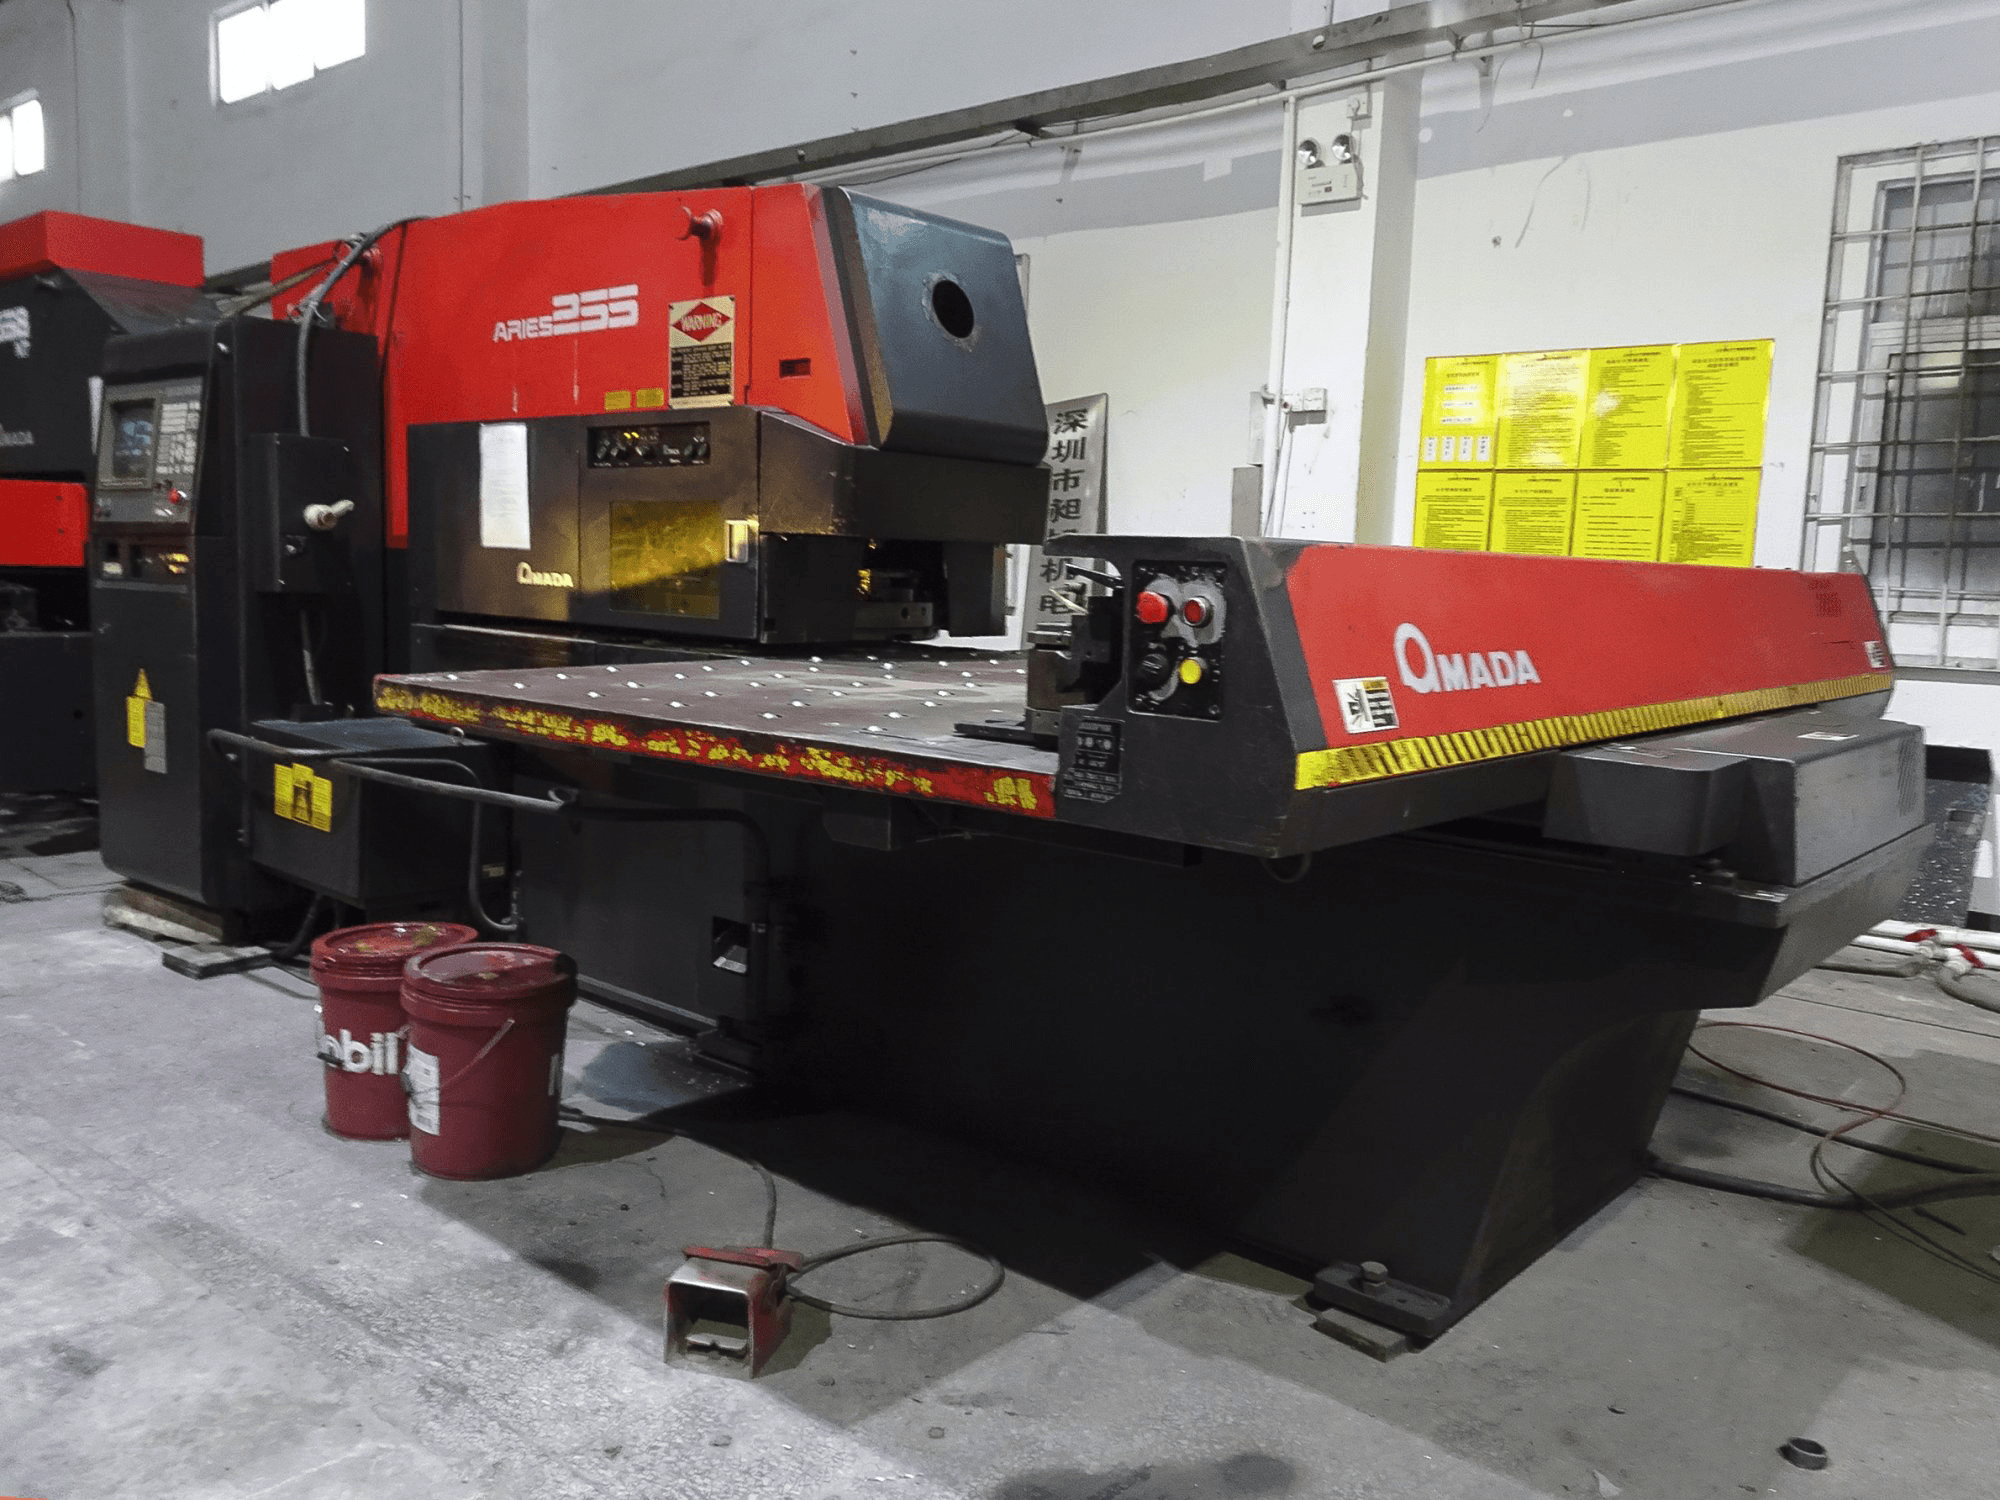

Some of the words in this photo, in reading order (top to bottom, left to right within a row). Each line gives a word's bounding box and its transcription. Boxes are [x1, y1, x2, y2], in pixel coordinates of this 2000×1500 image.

[493, 316, 553, 342] ARIES
[681, 312, 723, 332] WARNING
[1393, 622, 1541, 693] AMADA
